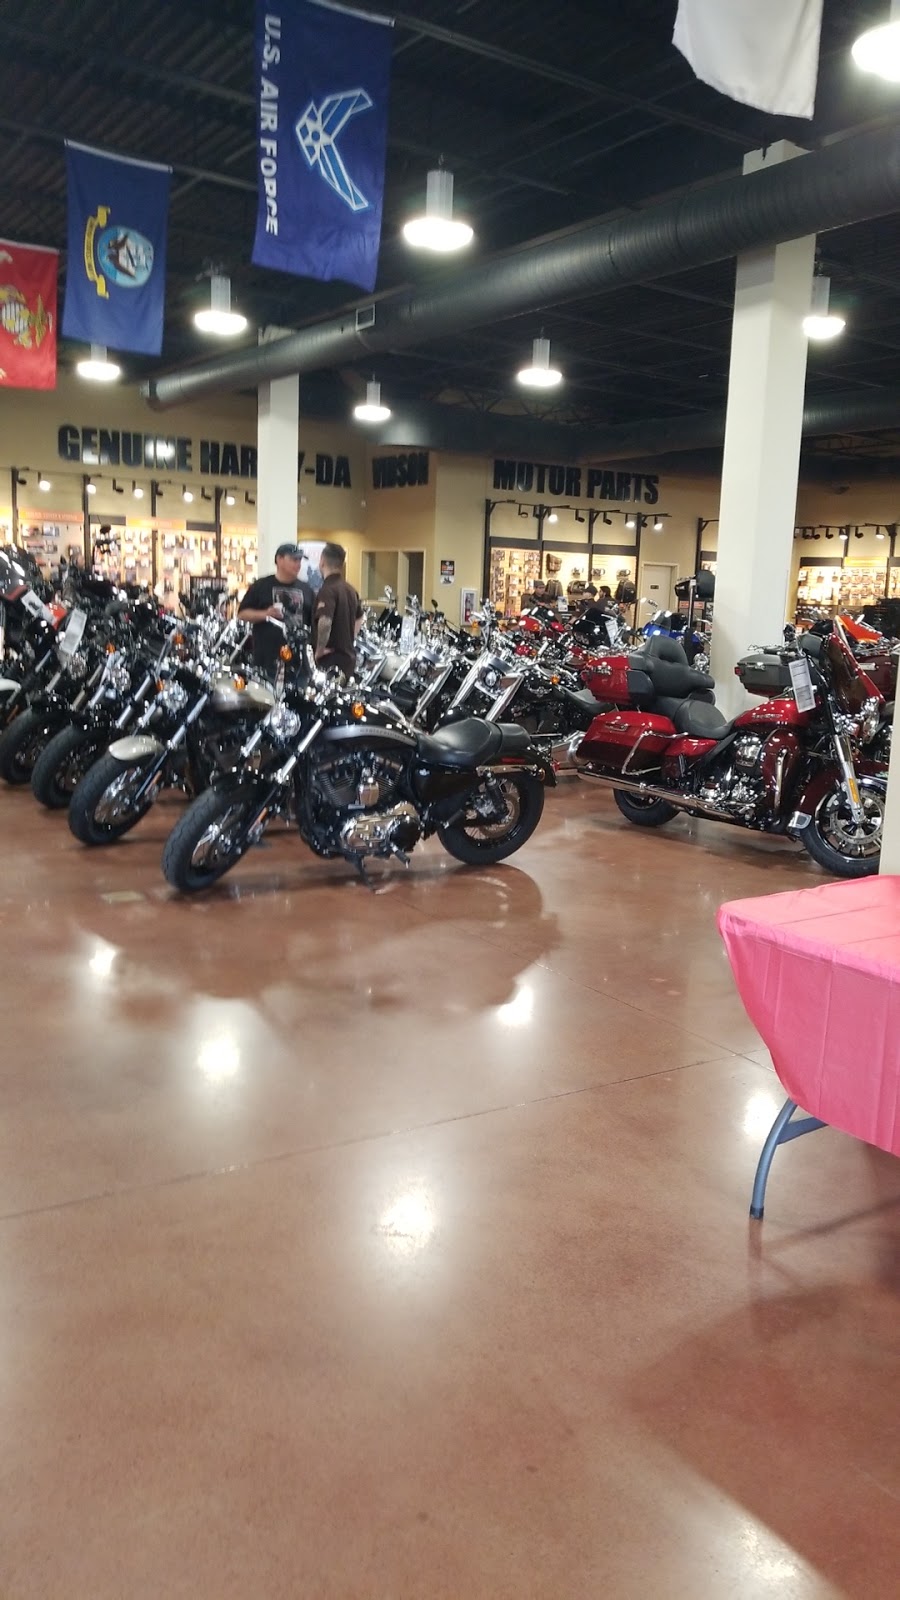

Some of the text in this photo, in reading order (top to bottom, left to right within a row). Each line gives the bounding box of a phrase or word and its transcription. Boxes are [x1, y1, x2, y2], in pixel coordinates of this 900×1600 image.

[260, 14, 282, 236] U.S. AIR FORCE
[58, 425, 192, 471] GENUINE
[493, 459, 659, 505] MOTOR PARTS
